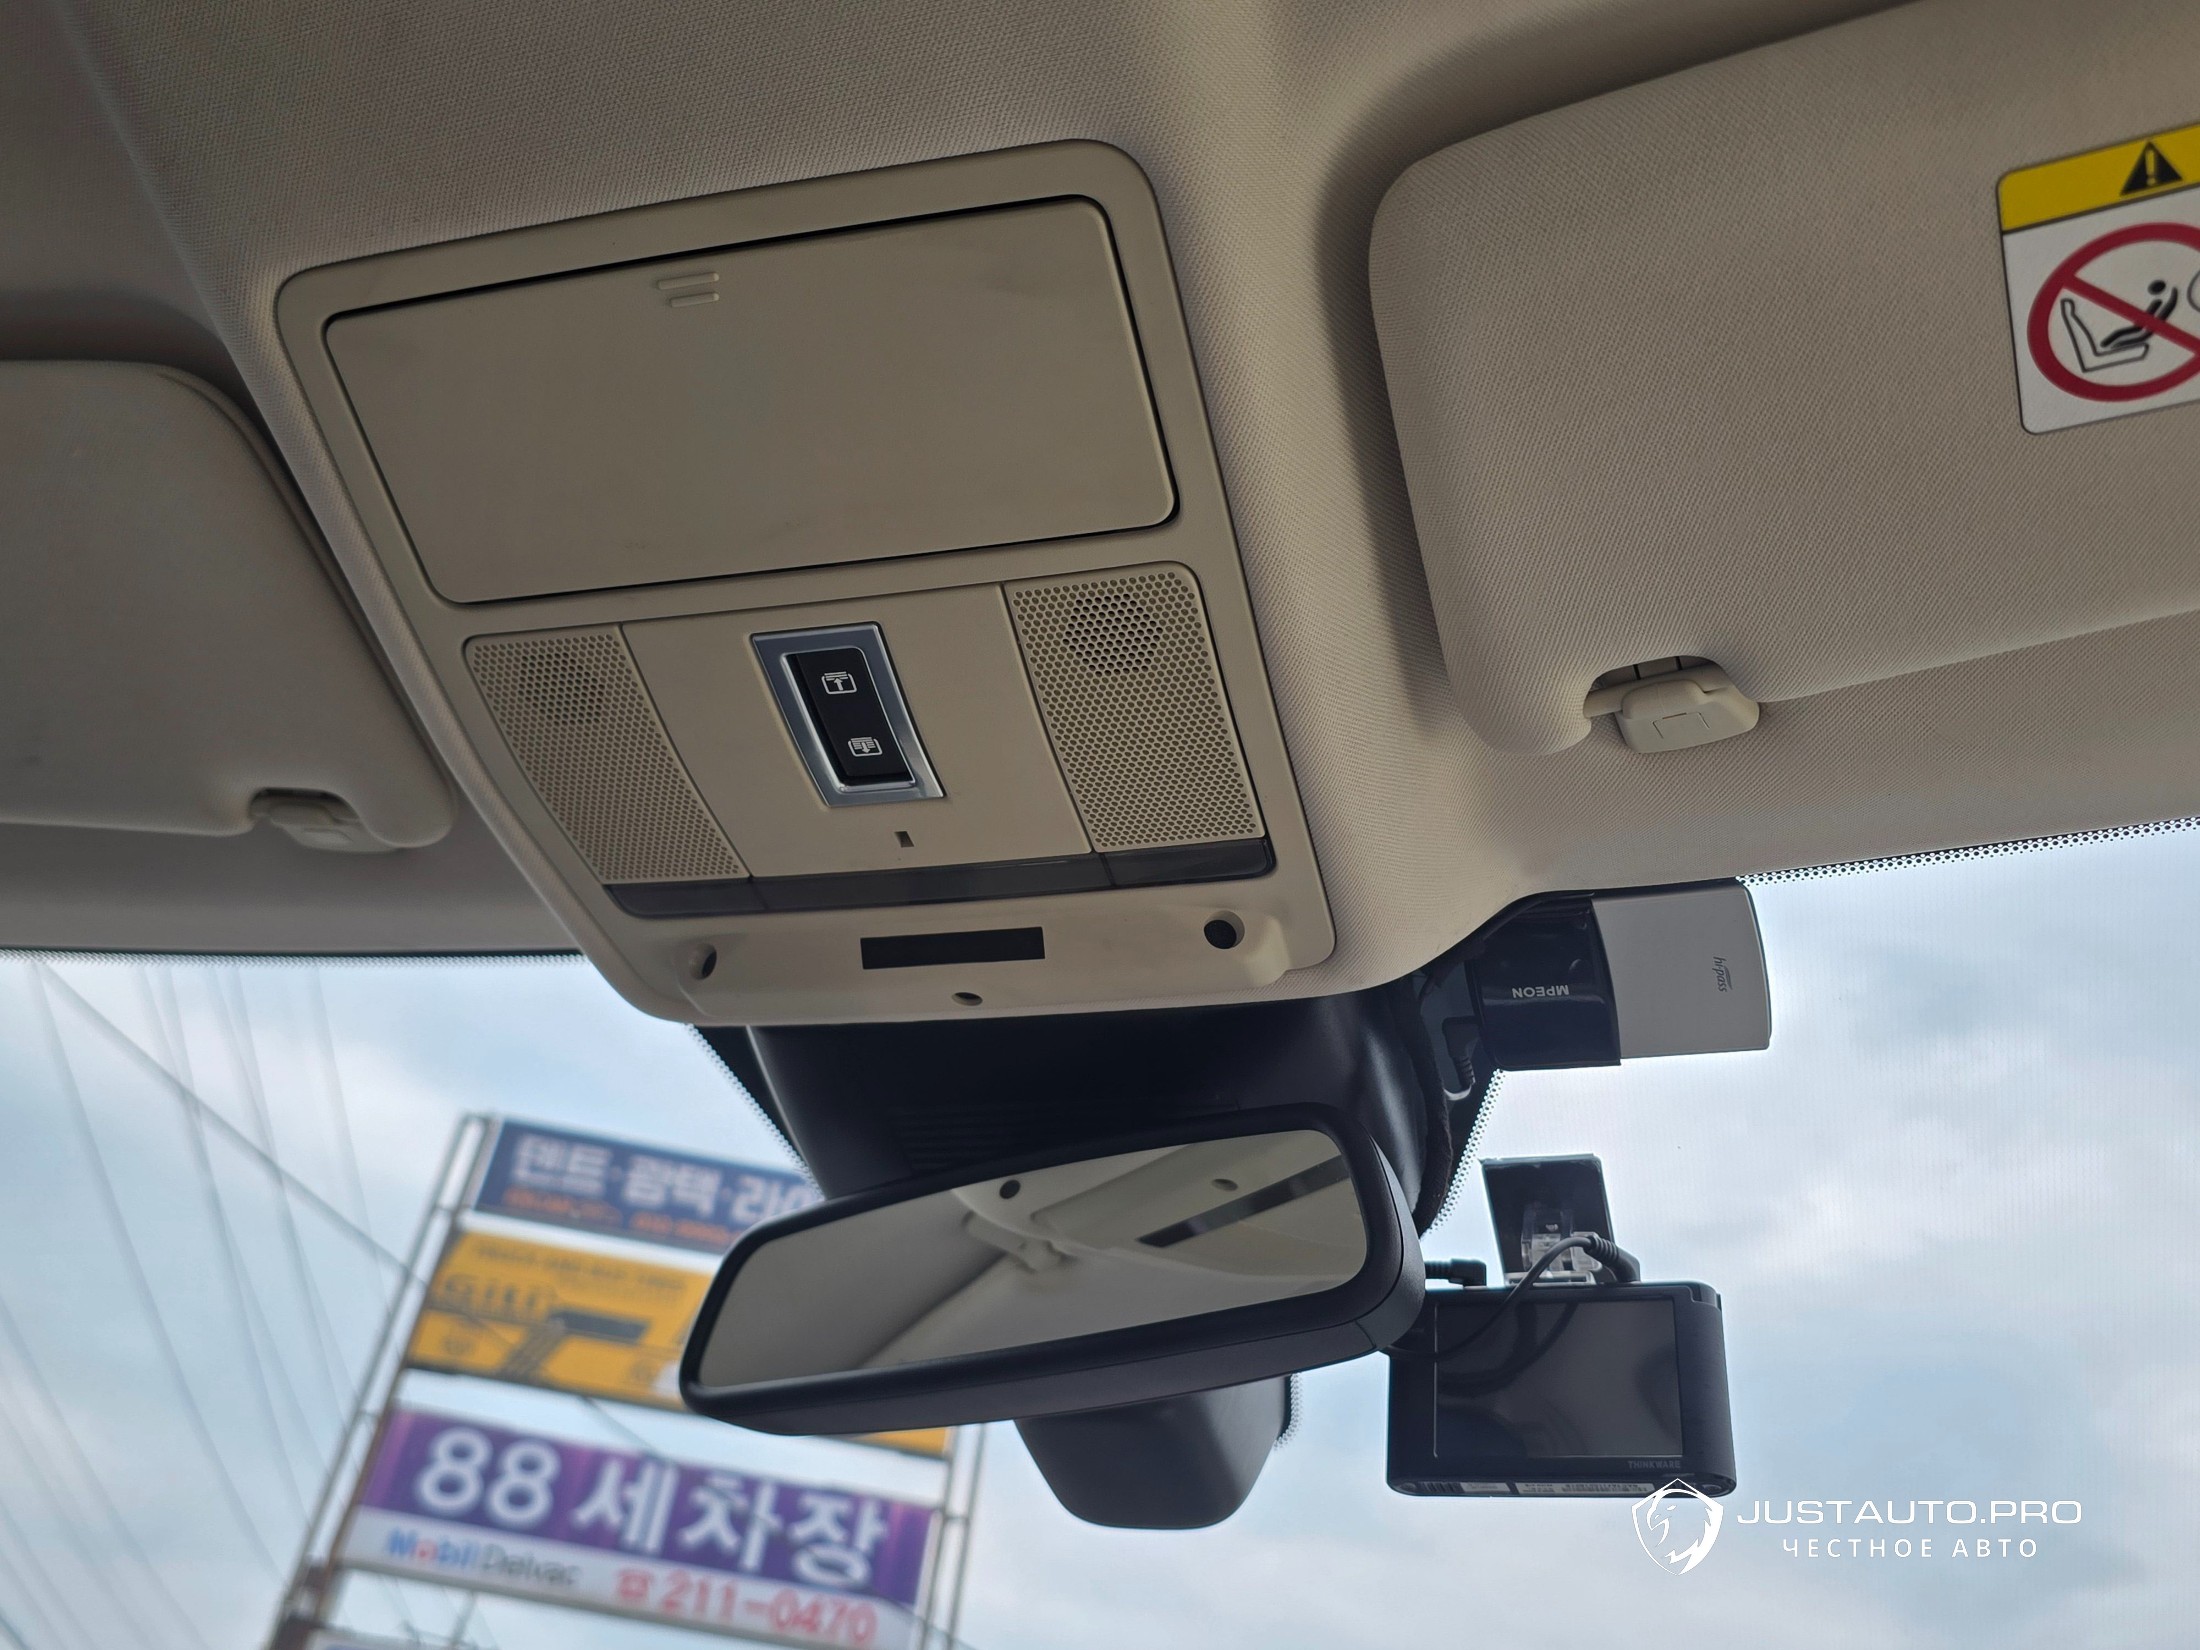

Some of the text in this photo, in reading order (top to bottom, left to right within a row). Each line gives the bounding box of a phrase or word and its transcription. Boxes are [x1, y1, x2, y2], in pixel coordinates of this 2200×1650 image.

[1511, 984, 1570, 999] MPEON
[1627, 1459, 1682, 1470] THINKWARE
[415, 1427, 889, 1588] 88 세차장
[385, 1527, 478, 1569] Mobil
[661, 1569, 879, 1647] 211-0470
